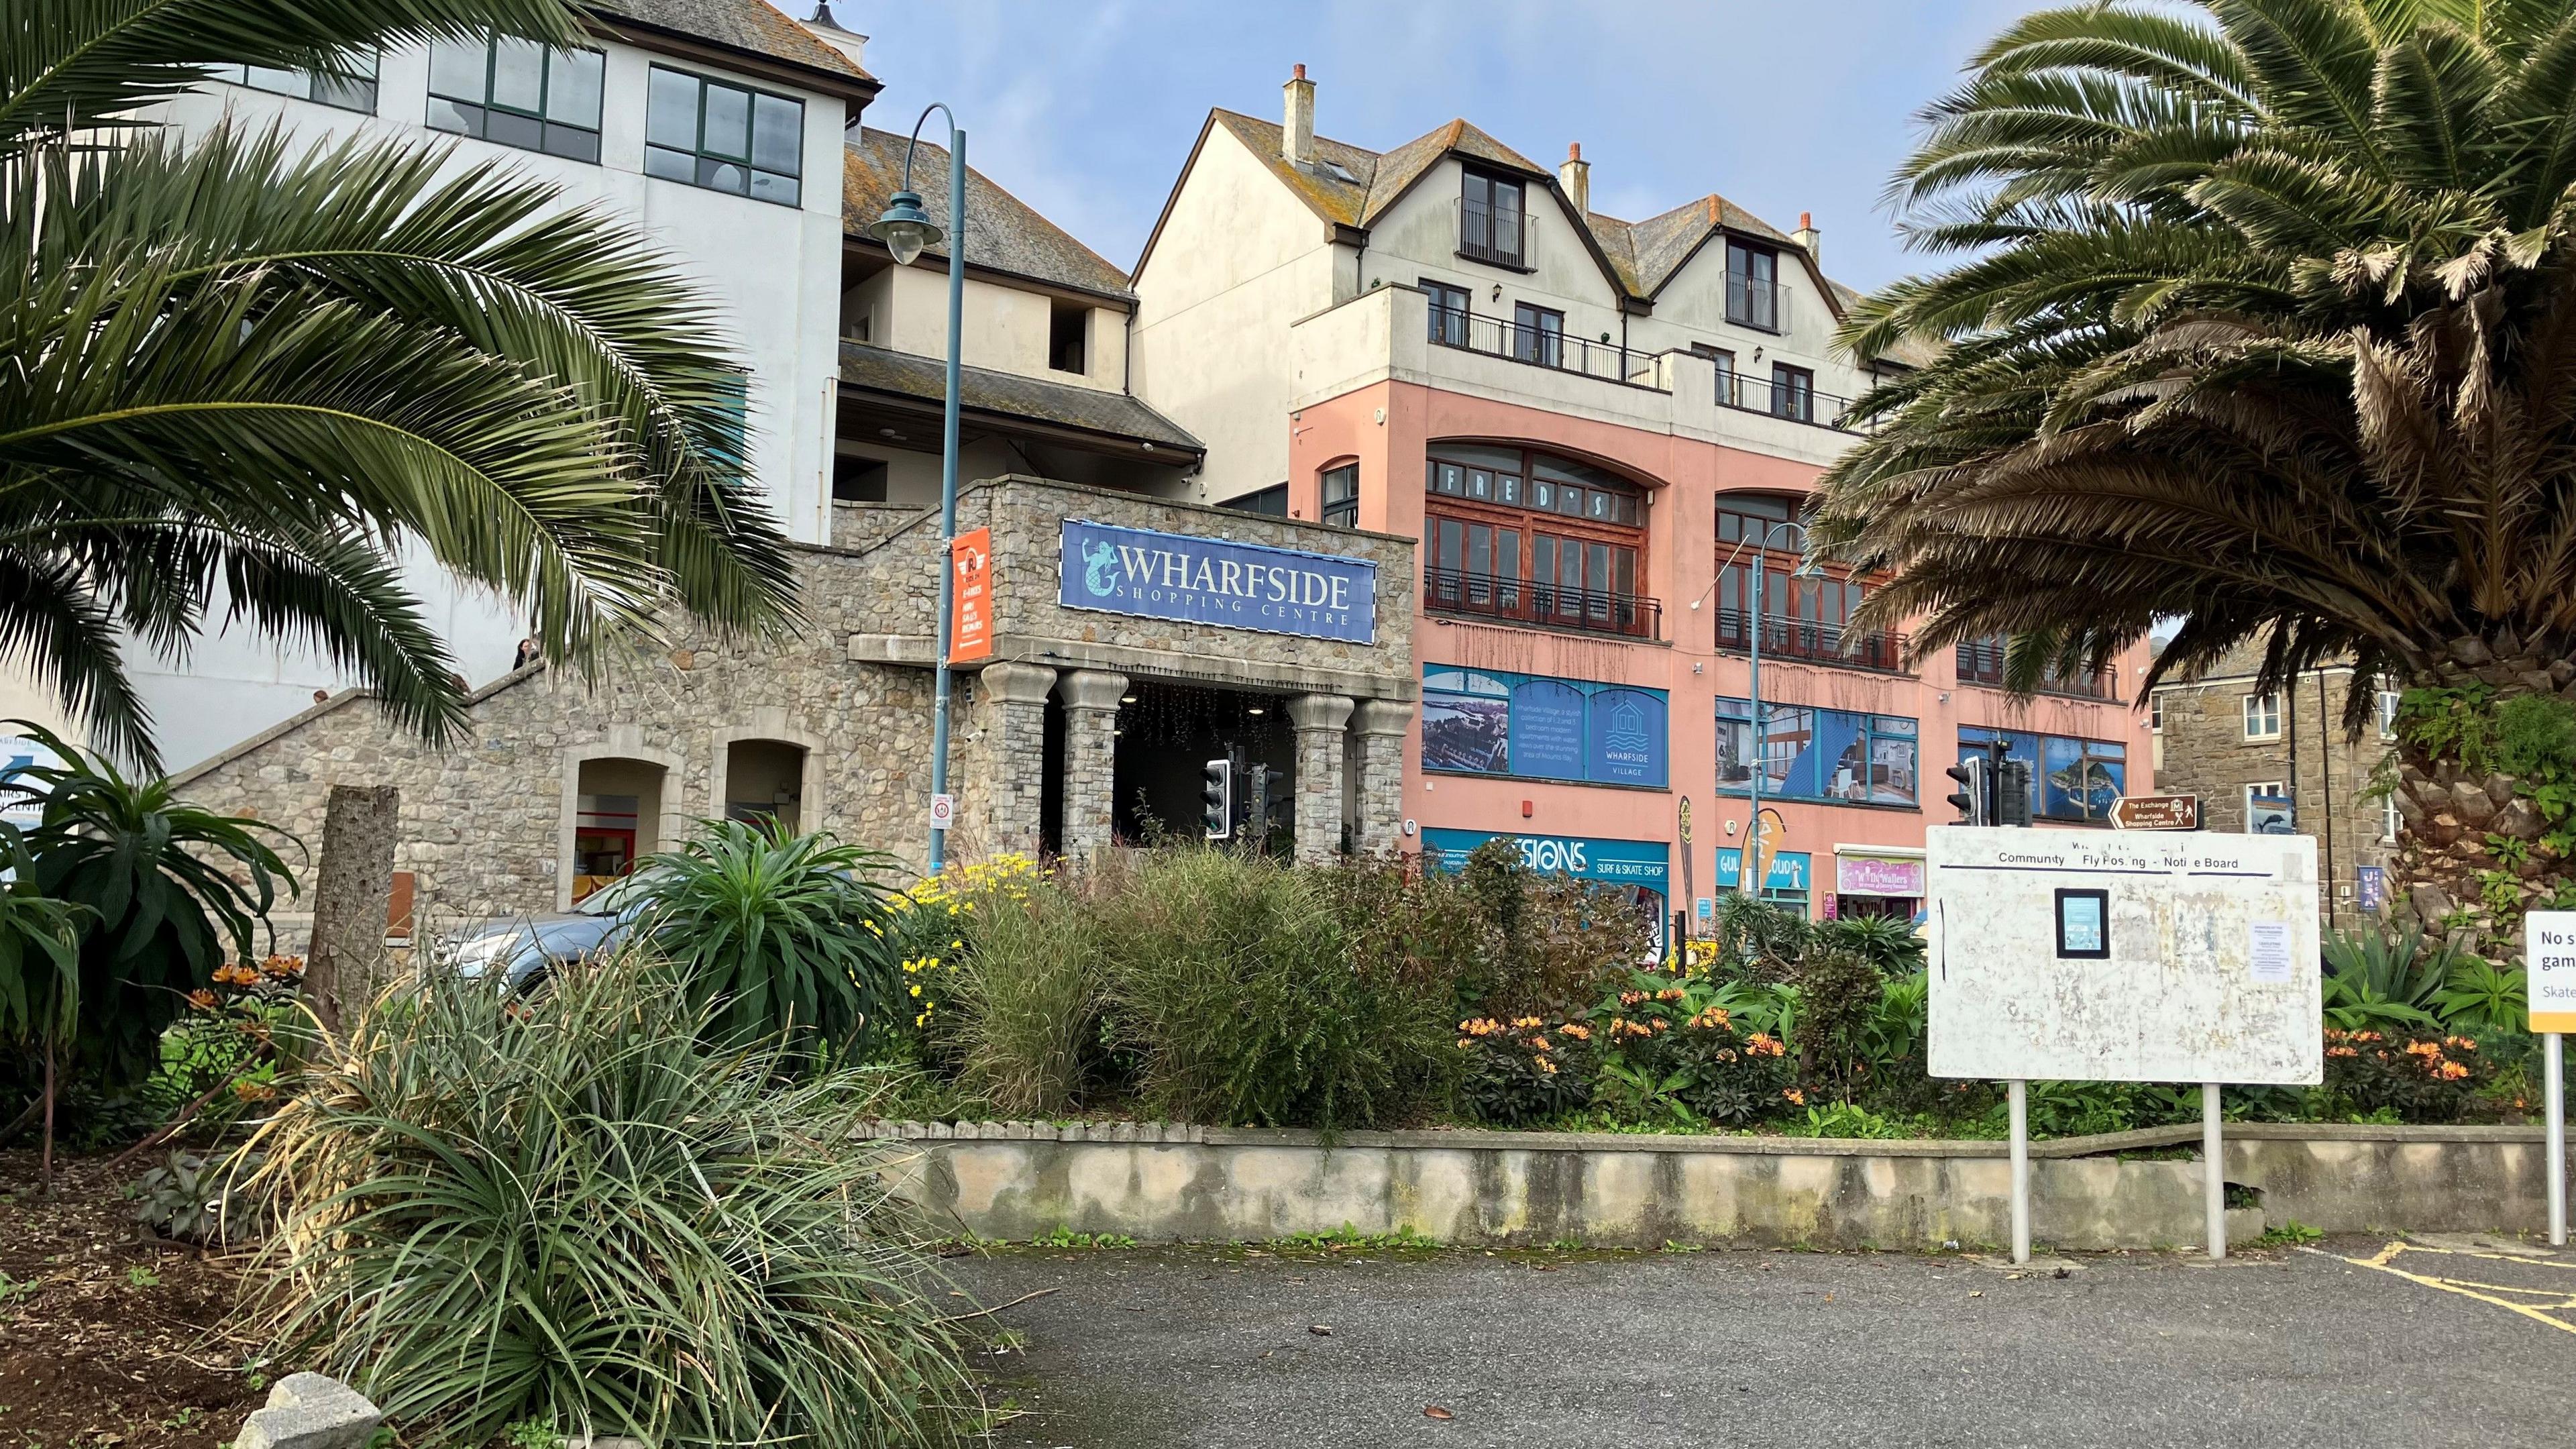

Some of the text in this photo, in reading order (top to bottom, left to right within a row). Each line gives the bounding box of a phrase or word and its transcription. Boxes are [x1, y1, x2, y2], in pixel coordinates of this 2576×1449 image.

[1117, 545, 1350, 610] WHARFSIDE
[1117, 585, 1348, 625] SHOPPING CENTRE
[1606, 751, 1648, 763] WHARFSIDE
[1613, 767, 1642, 776] VILLAGE
[2141, 801, 2169, 809] Exchange
[2135, 812, 2164, 820] Wharfside
[1490, 837, 1587, 872] SIONS
[1720, 855, 1790, 875] GUL OUD
[2083, 855, 2099, 867] Fly
[2103, 855, 2145, 869] Posng
[2164, 857, 2200, 867] Notie
[2204, 858, 2239, 868] Board
[1597, 863, 1664, 876] SURF & SKATE SHOP
[2541, 931, 2576, 945] No s
